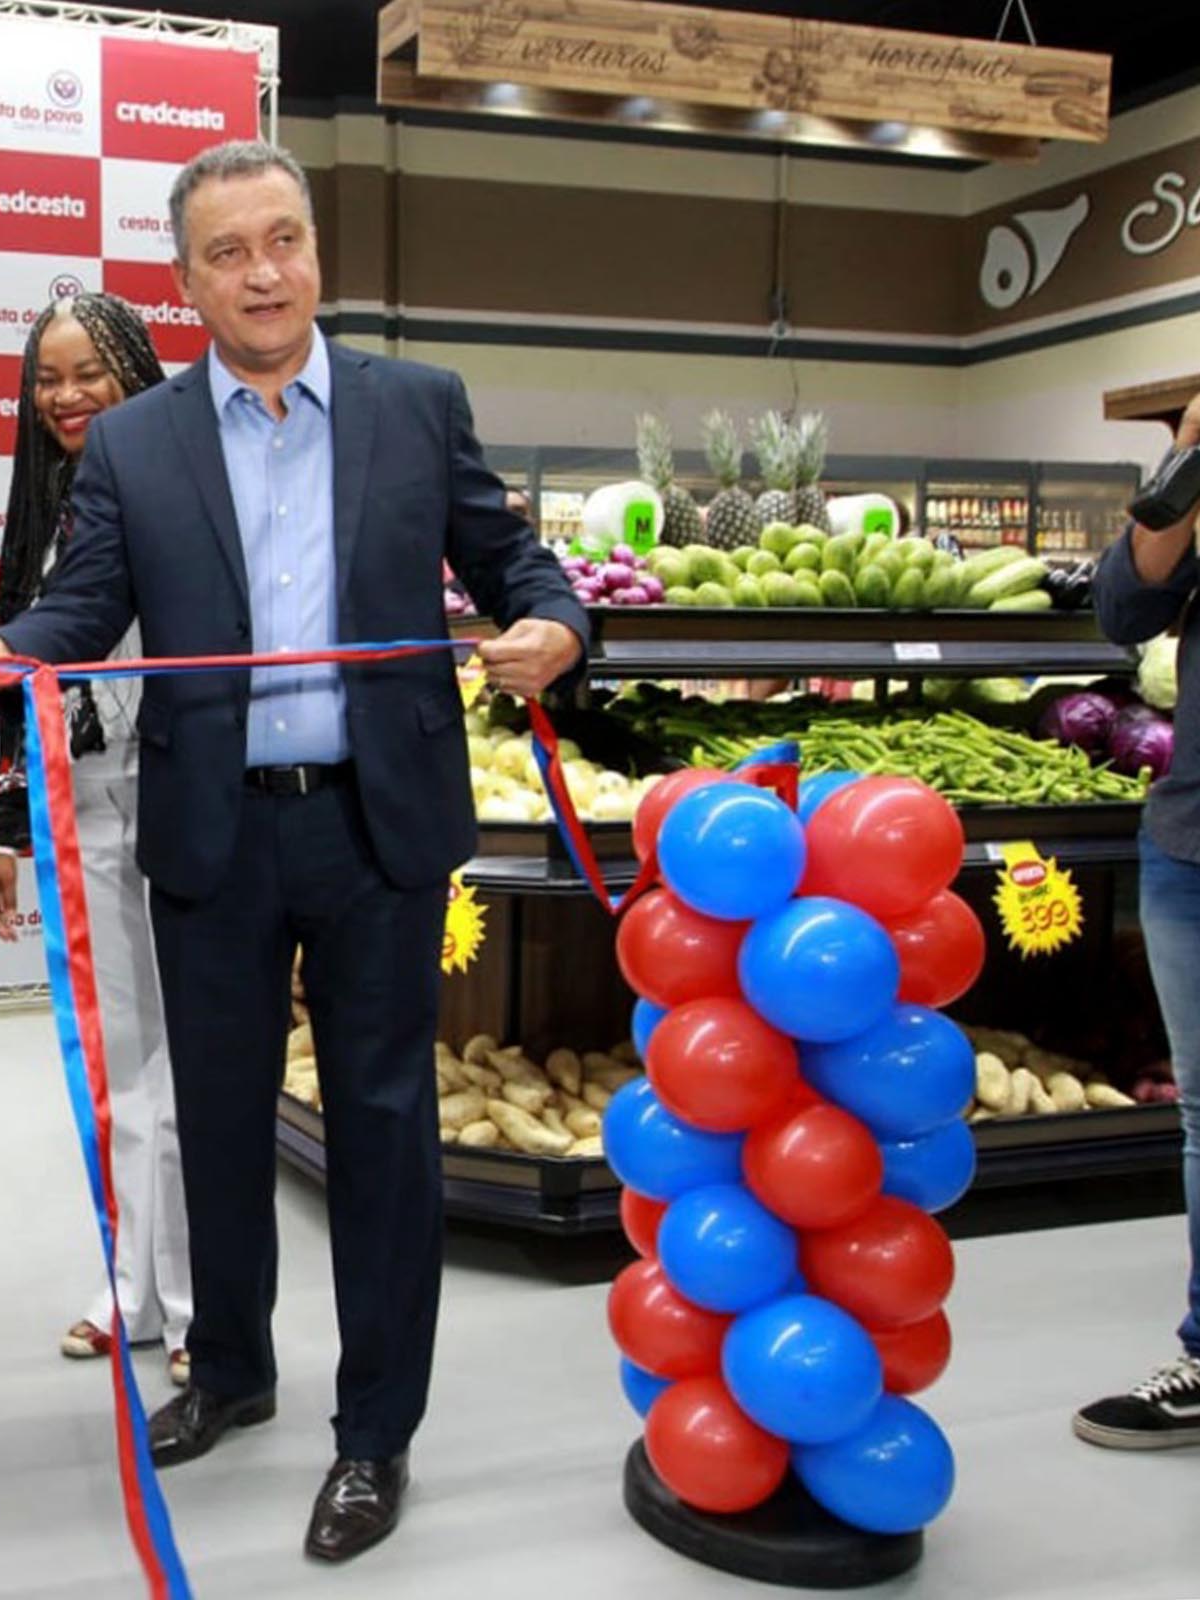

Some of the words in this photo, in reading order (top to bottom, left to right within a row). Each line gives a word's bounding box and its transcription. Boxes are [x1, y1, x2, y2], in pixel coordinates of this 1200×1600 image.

[497, 38, 668, 75] verduras
[20, 104, 40, 121] do
[45, 108, 83, 125] povo
[115, 100, 225, 131] credcesta
[119, 215, 160, 233] cesta
